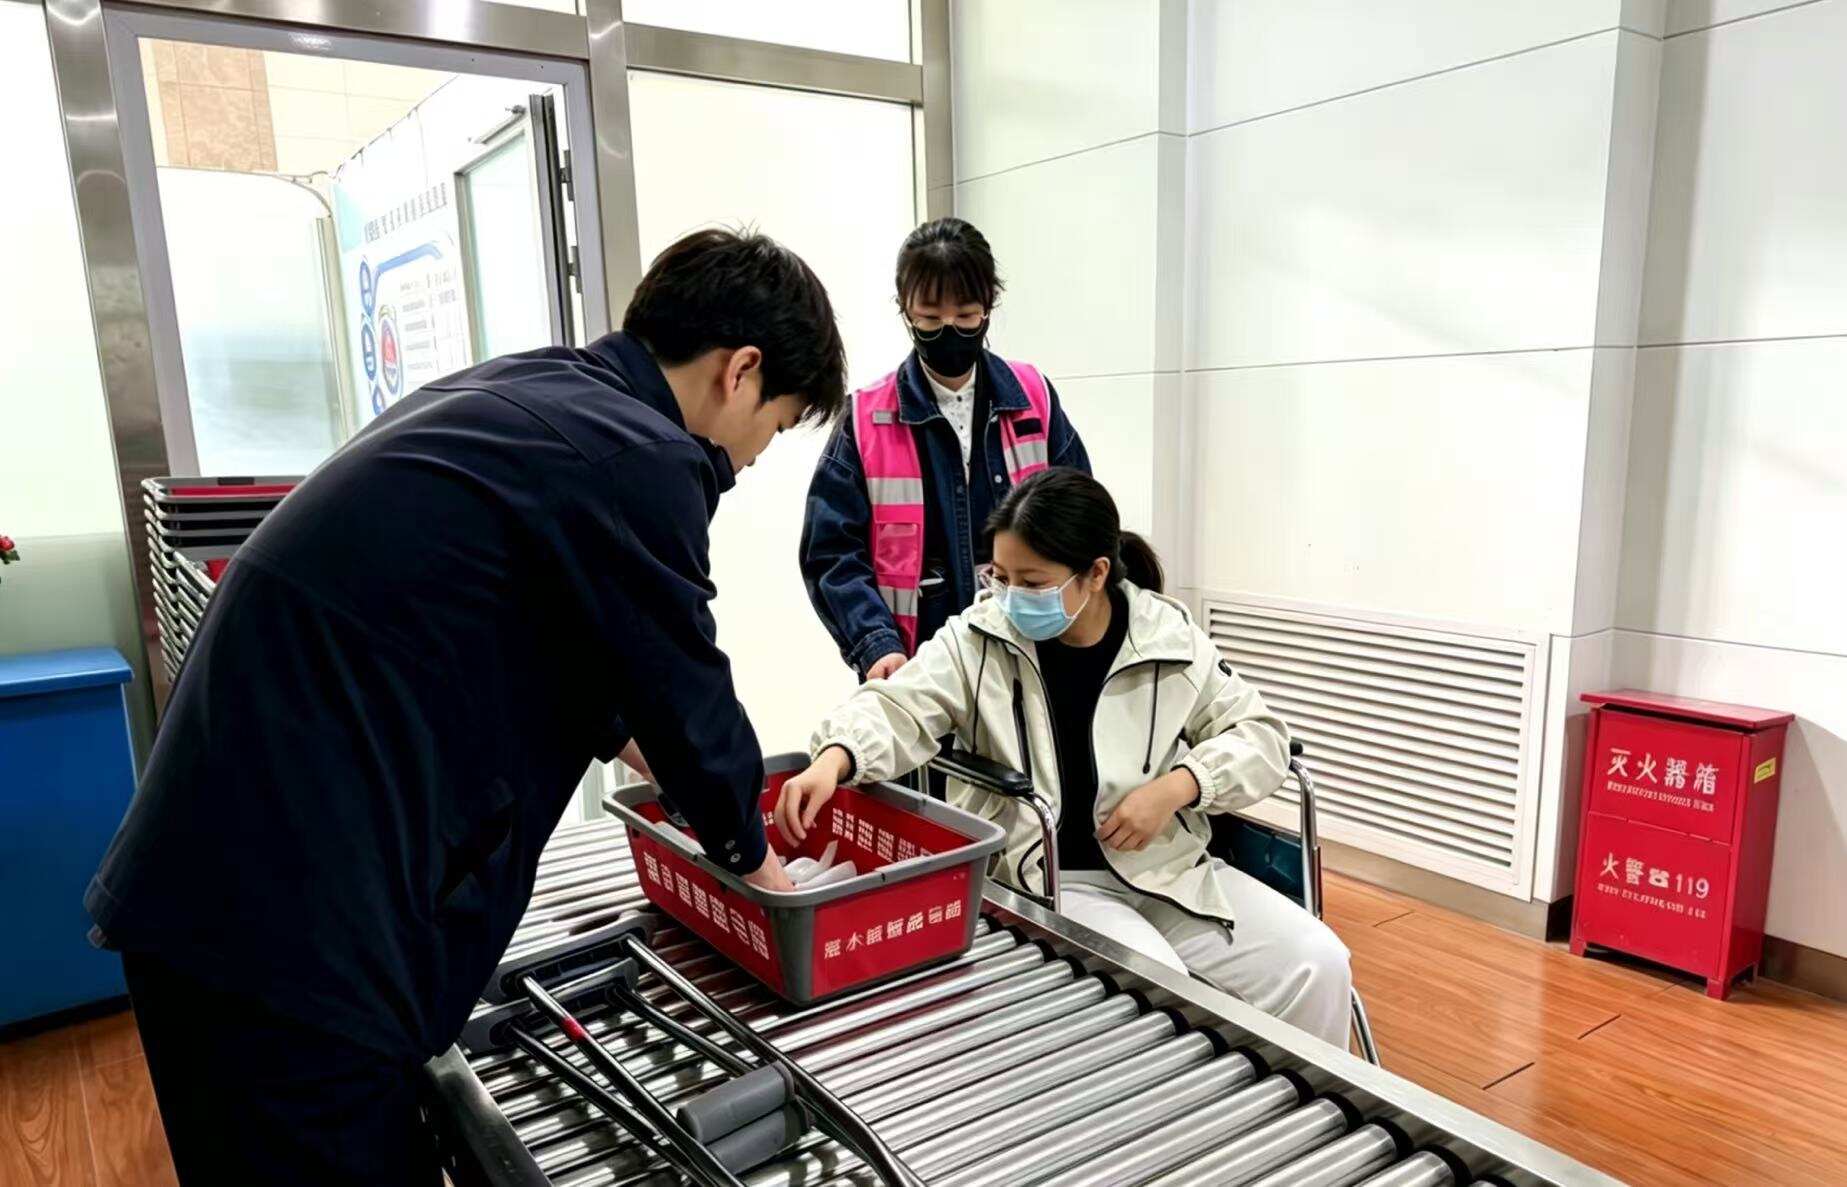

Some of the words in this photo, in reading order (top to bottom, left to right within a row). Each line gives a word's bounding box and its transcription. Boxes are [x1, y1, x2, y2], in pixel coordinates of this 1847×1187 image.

[1607, 747, 1719, 795] 灭火器箱
[1600, 852, 1645, 886] 火警
[1676, 873, 1710, 899] 119
